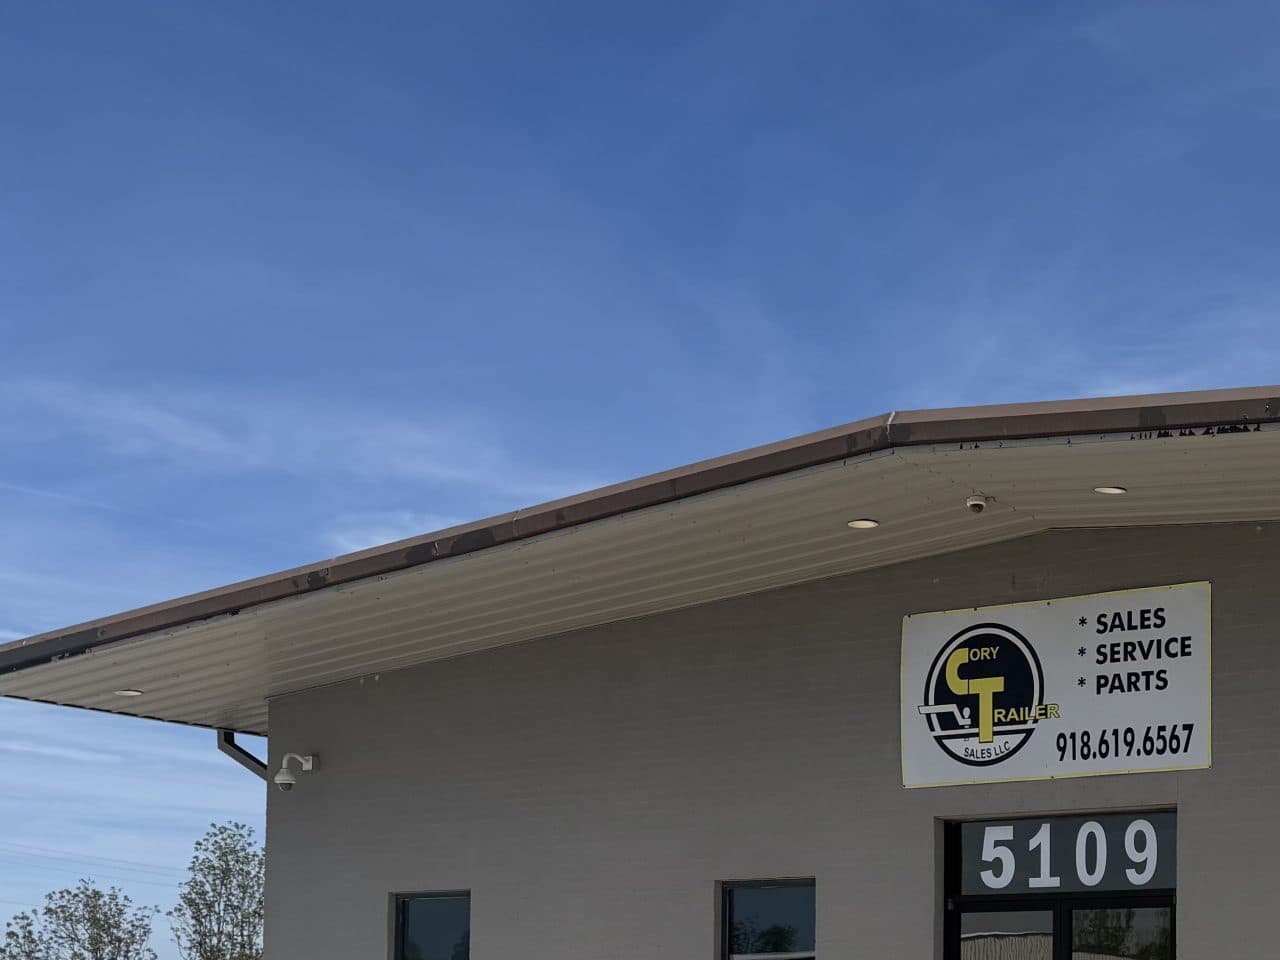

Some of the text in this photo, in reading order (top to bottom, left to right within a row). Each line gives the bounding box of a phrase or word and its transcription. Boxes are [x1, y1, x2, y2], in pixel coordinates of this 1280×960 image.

[1096, 607, 1166, 634] SALES
[1096, 636, 1192, 665] SERVICE
[1096, 669, 1169, 695] PARTS
[963, 741, 1011, 759] SALES LLC
[1056, 723, 1194, 761] 918.619.6567
[979, 818, 1158, 889] 5109
